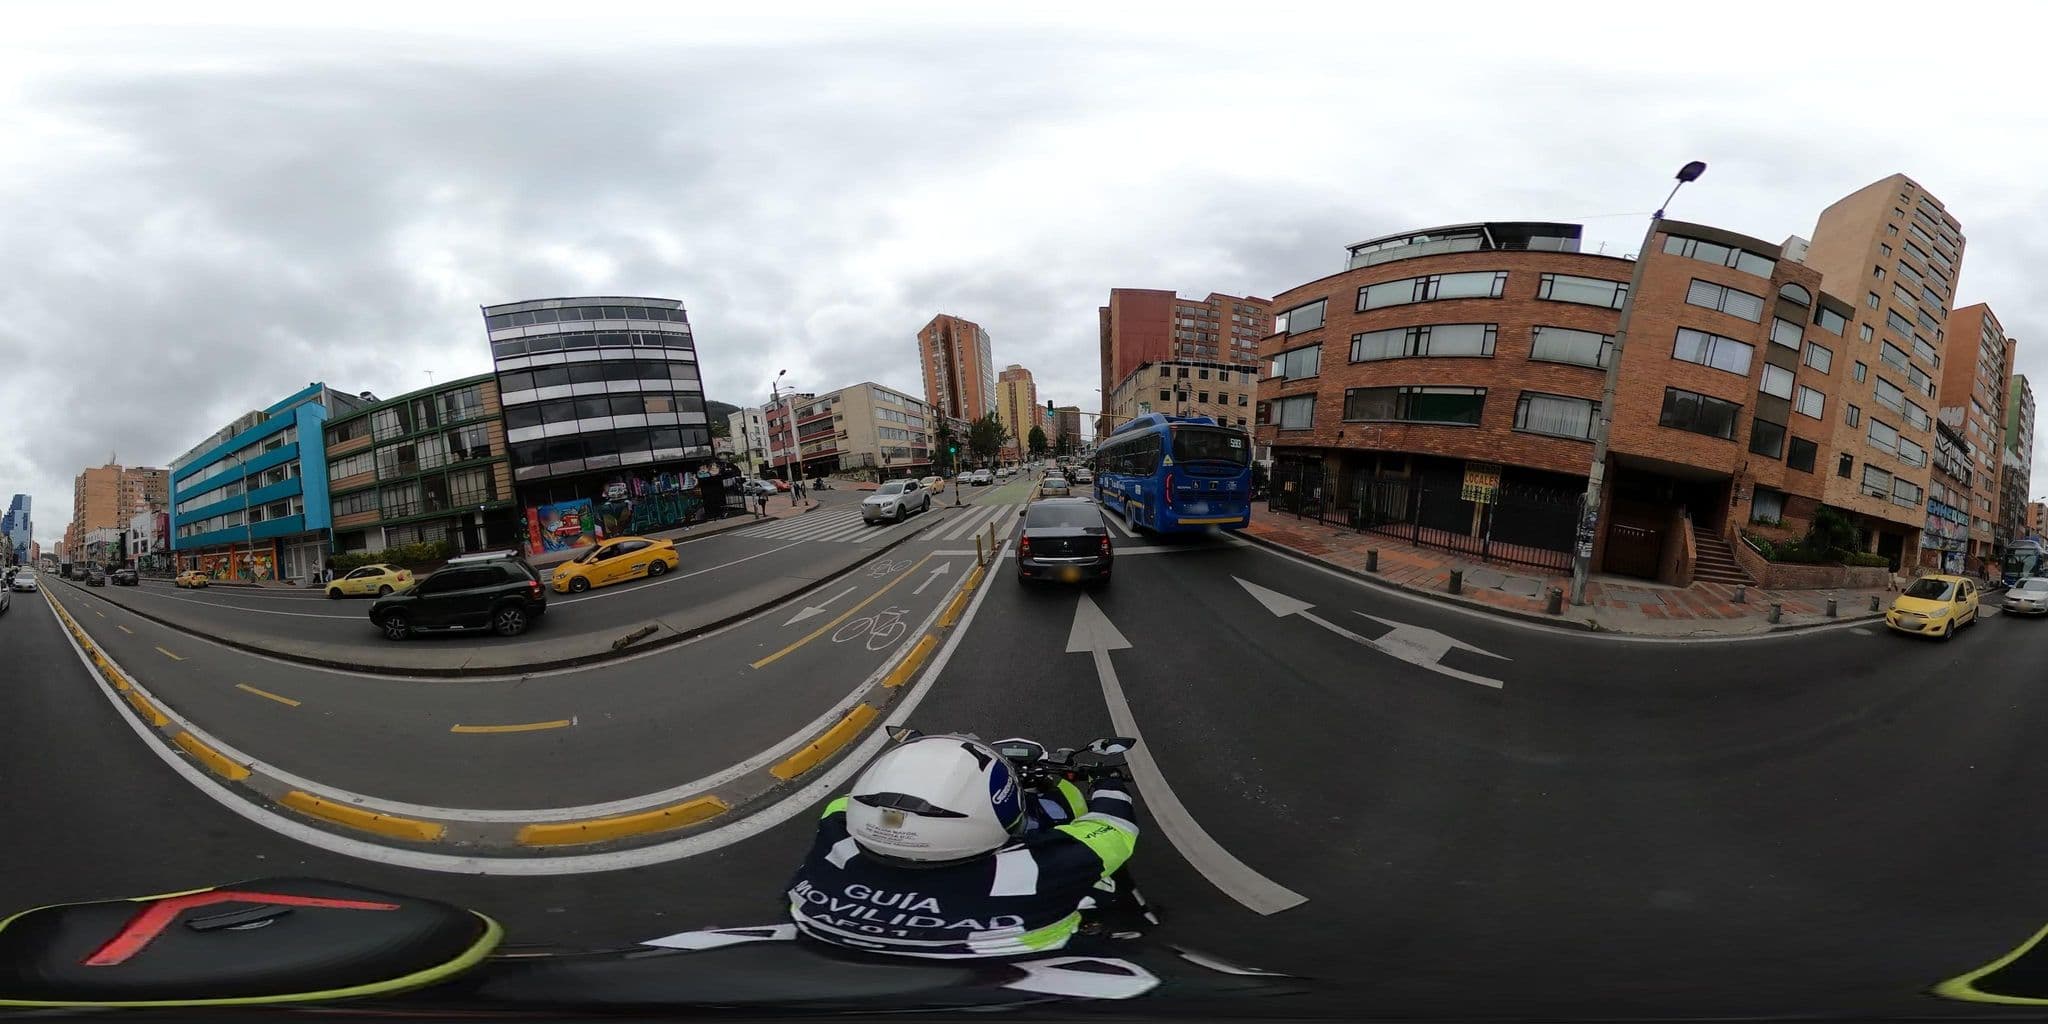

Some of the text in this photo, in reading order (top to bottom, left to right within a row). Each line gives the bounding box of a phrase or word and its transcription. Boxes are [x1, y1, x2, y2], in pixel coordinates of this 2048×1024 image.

[1464, 471, 1499, 487] LOCALES
[795, 879, 1025, 931] MOVILIDAD
[844, 884, 941, 914] GUÍA
[812, 913, 910, 937] AF01
